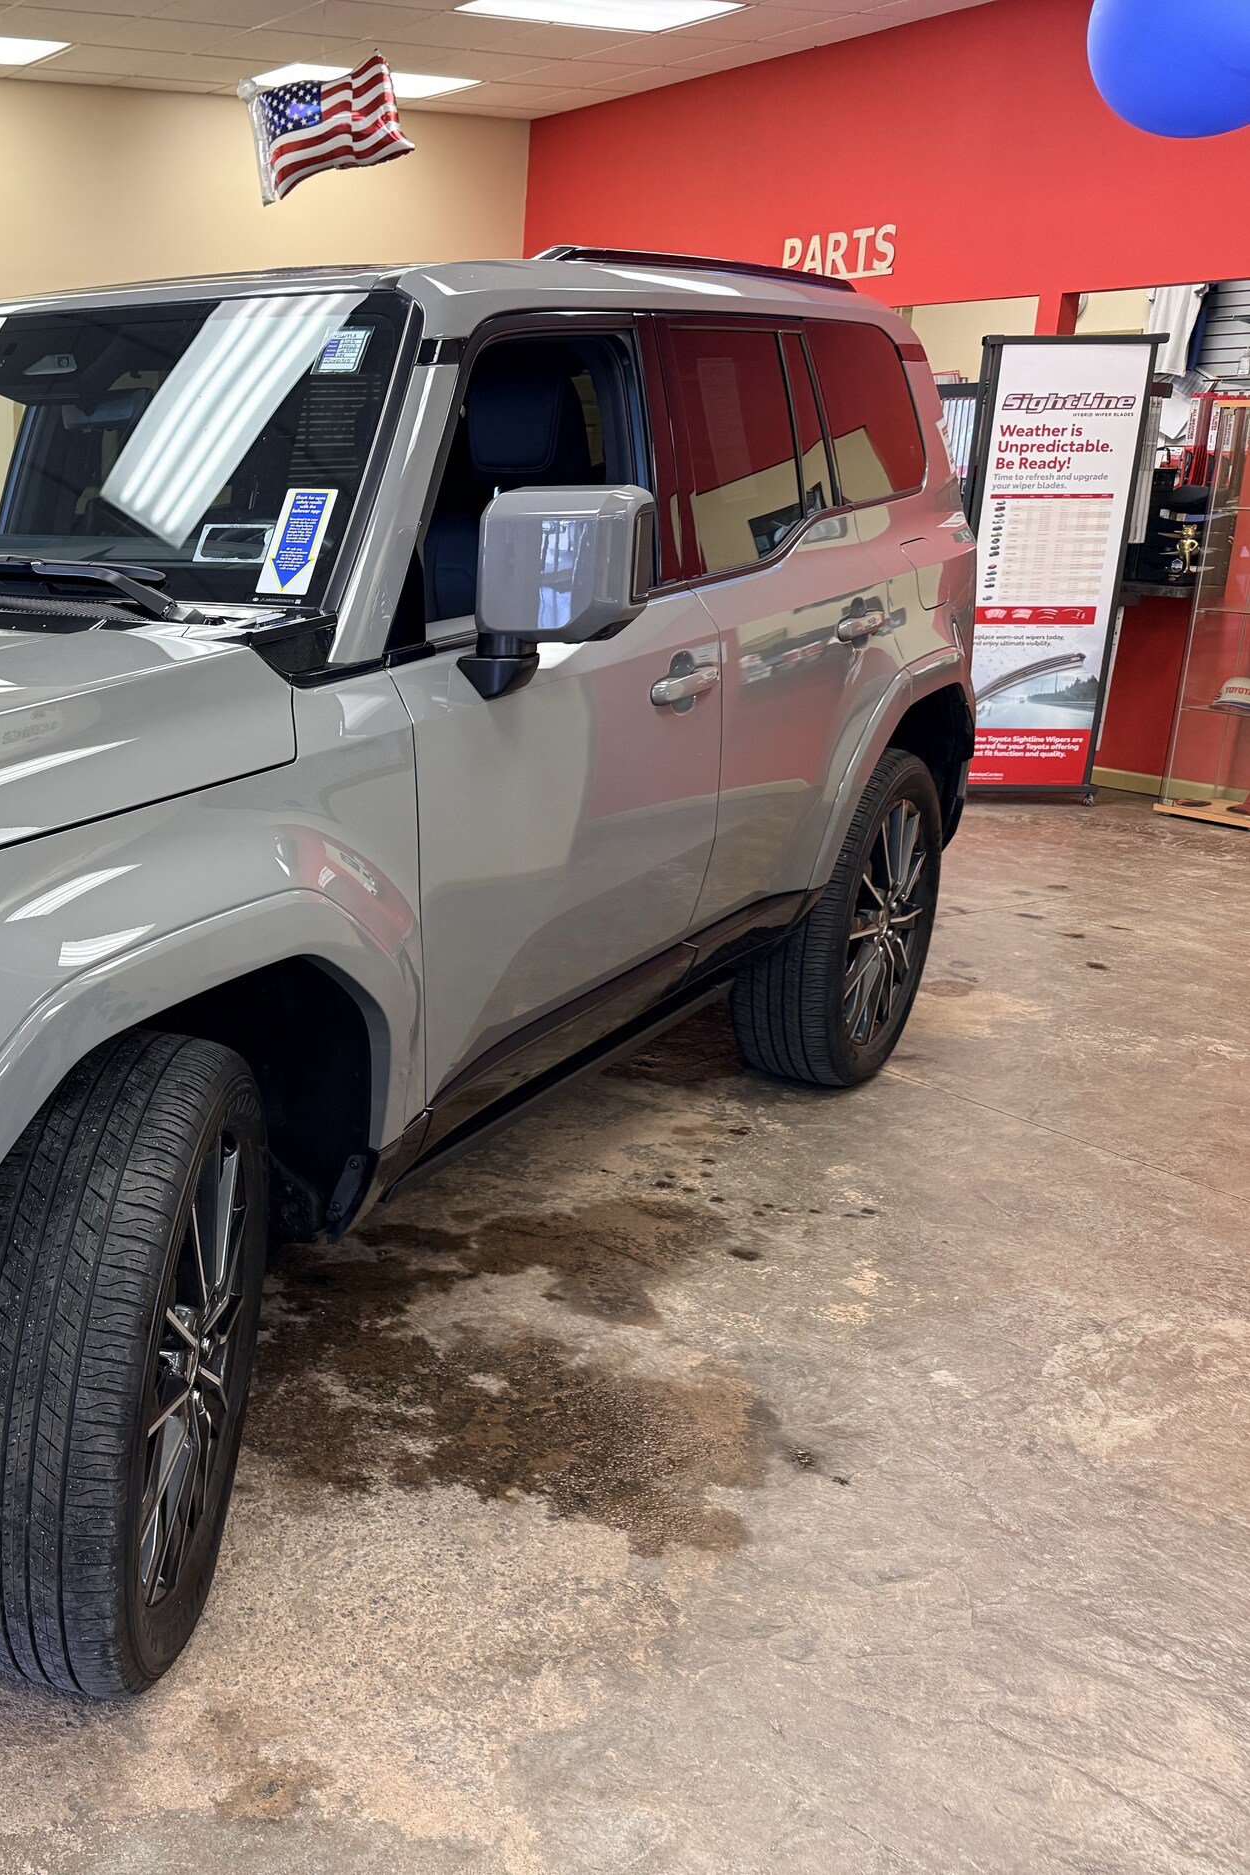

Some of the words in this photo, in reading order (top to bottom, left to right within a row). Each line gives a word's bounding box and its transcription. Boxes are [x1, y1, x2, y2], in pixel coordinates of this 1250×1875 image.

[782, 223, 897, 277] PARTS
[1002, 392, 1136, 414] SightLine
[1000, 424, 1068, 437] Weather
[1071, 424, 1083, 437] is
[998, 440, 1113, 456] Unpredictable.
[995, 458, 1015, 470] Be
[1019, 456, 1071, 472] Ready!
[993, 473, 1012, 481] Time
[1025, 473, 1055, 481] refresh
[1073, 474, 1108, 483] upgrade
[1012, 483, 1036, 492] wiper
[1037, 482, 1067, 490] blades.
[987, 736, 1012, 744] Toyota
[1012, 736, 1045, 744] Sightline
[1045, 736, 1070, 744] Wipers
[1026, 743, 1050, 751] Toyota
[1050, 743, 1079, 752] offering
[1040, 750, 1066, 759] quality.
